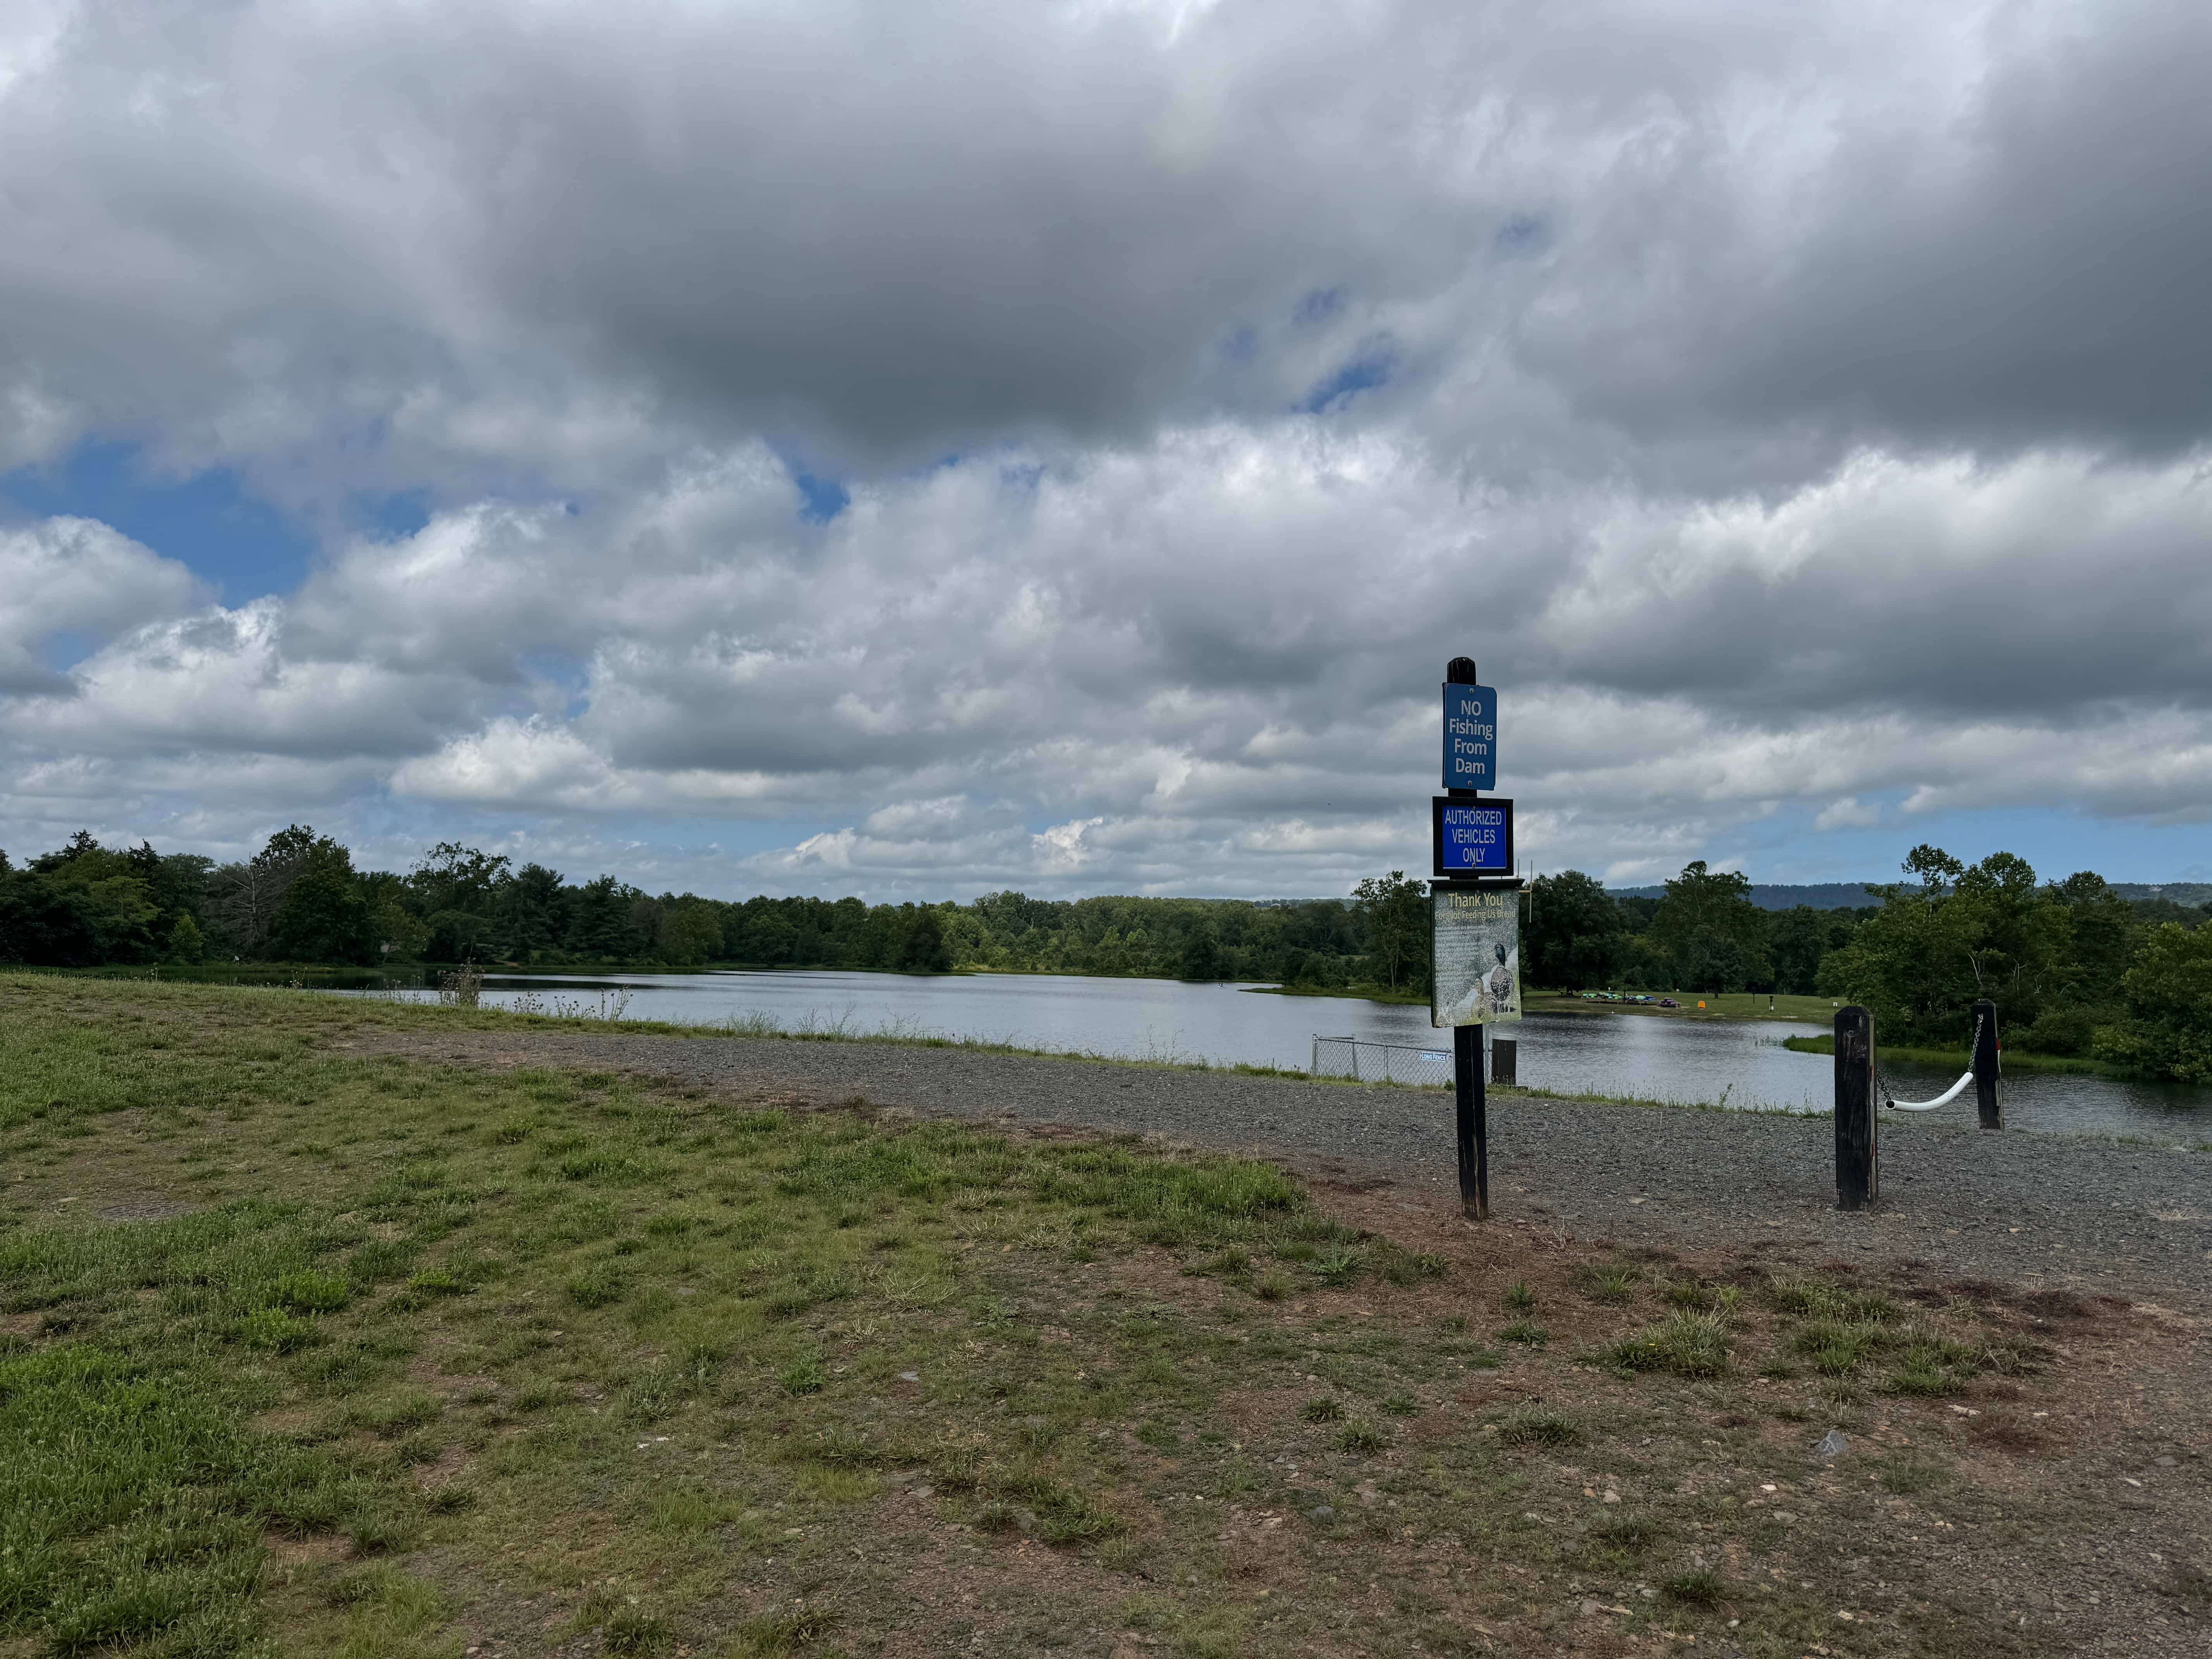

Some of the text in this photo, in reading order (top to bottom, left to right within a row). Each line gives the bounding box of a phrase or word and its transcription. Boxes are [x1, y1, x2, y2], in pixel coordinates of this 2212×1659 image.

[1461, 700, 1482, 716] NO
[1449, 718, 1493, 740] Fishing
[1455, 738, 1487, 755] From
[1456, 758, 1485, 774] Dam
[1445, 810, 1502, 825] AUTHORIZED
[1452, 829, 1495, 843] VEHICLES
[1463, 848, 1485, 862] ONLY
[1448, 893, 1503, 907] Thank You
[1462, 910, 1486, 921] Feeding
[1487, 908, 1496, 918] Us
[1497, 908, 1516, 918] Bread
